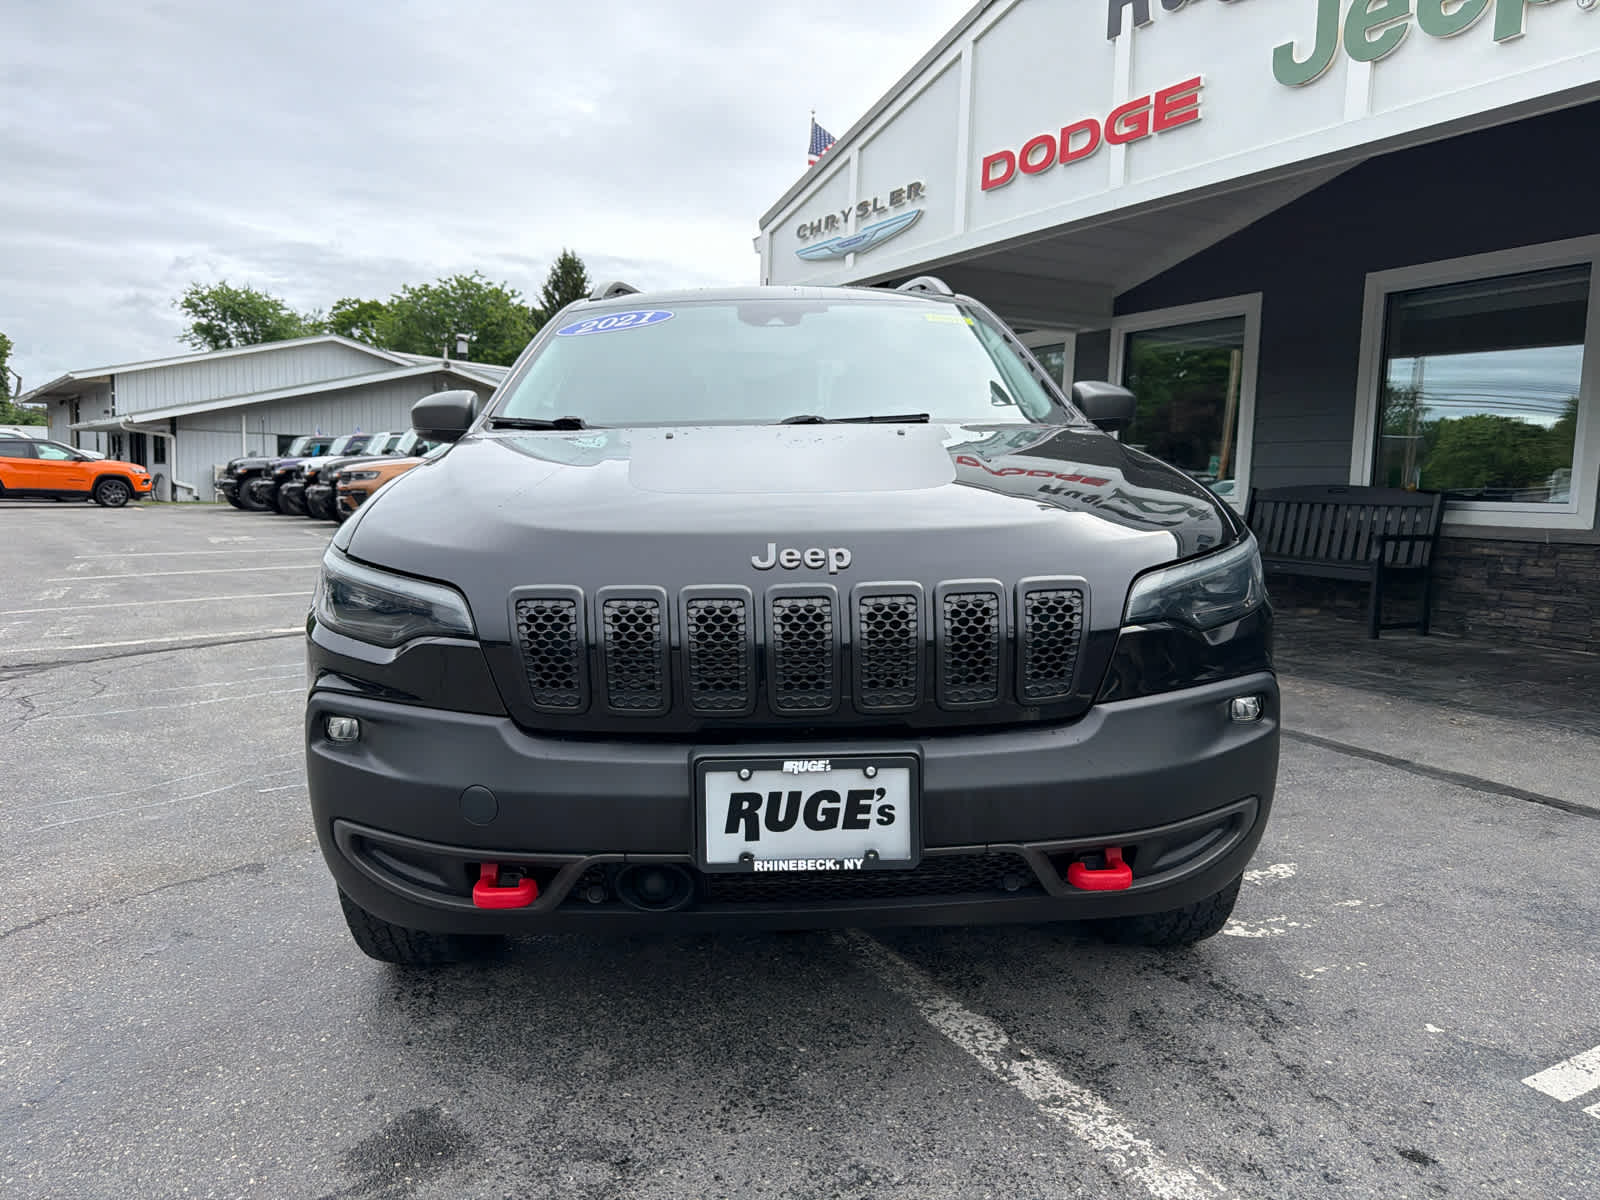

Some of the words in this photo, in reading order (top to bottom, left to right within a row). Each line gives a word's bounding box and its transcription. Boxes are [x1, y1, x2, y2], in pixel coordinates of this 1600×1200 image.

[981, 76, 1203, 191] DODGE
[797, 181, 926, 239] CHRYSLER
[575, 311, 656, 334] 2021
[751, 542, 852, 575] Jeep
[753, 859, 840, 872] RHINEBECK,
[843, 858, 864, 871] NY
